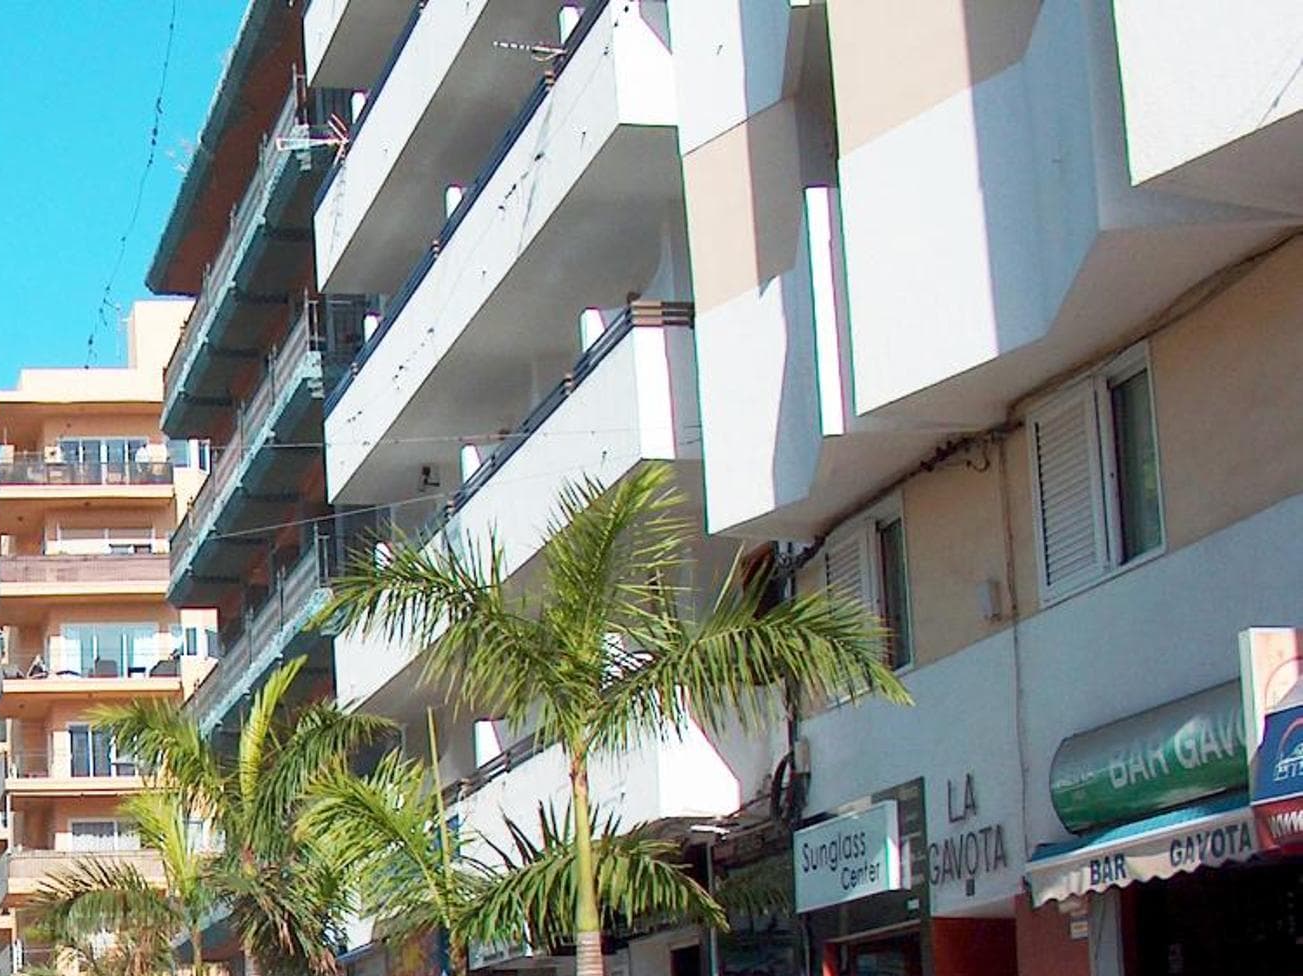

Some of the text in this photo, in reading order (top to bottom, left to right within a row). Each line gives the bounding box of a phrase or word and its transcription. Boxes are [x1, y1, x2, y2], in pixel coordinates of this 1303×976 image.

[1173, 707, 1246, 770] GAV
[947, 773, 978, 823] LA
[801, 831, 867, 874] Sunglass
[840, 861, 880, 891] Center
[928, 823, 1009, 886] GAVOTA
[1089, 821, 1252, 886] BAR GAVOTA
